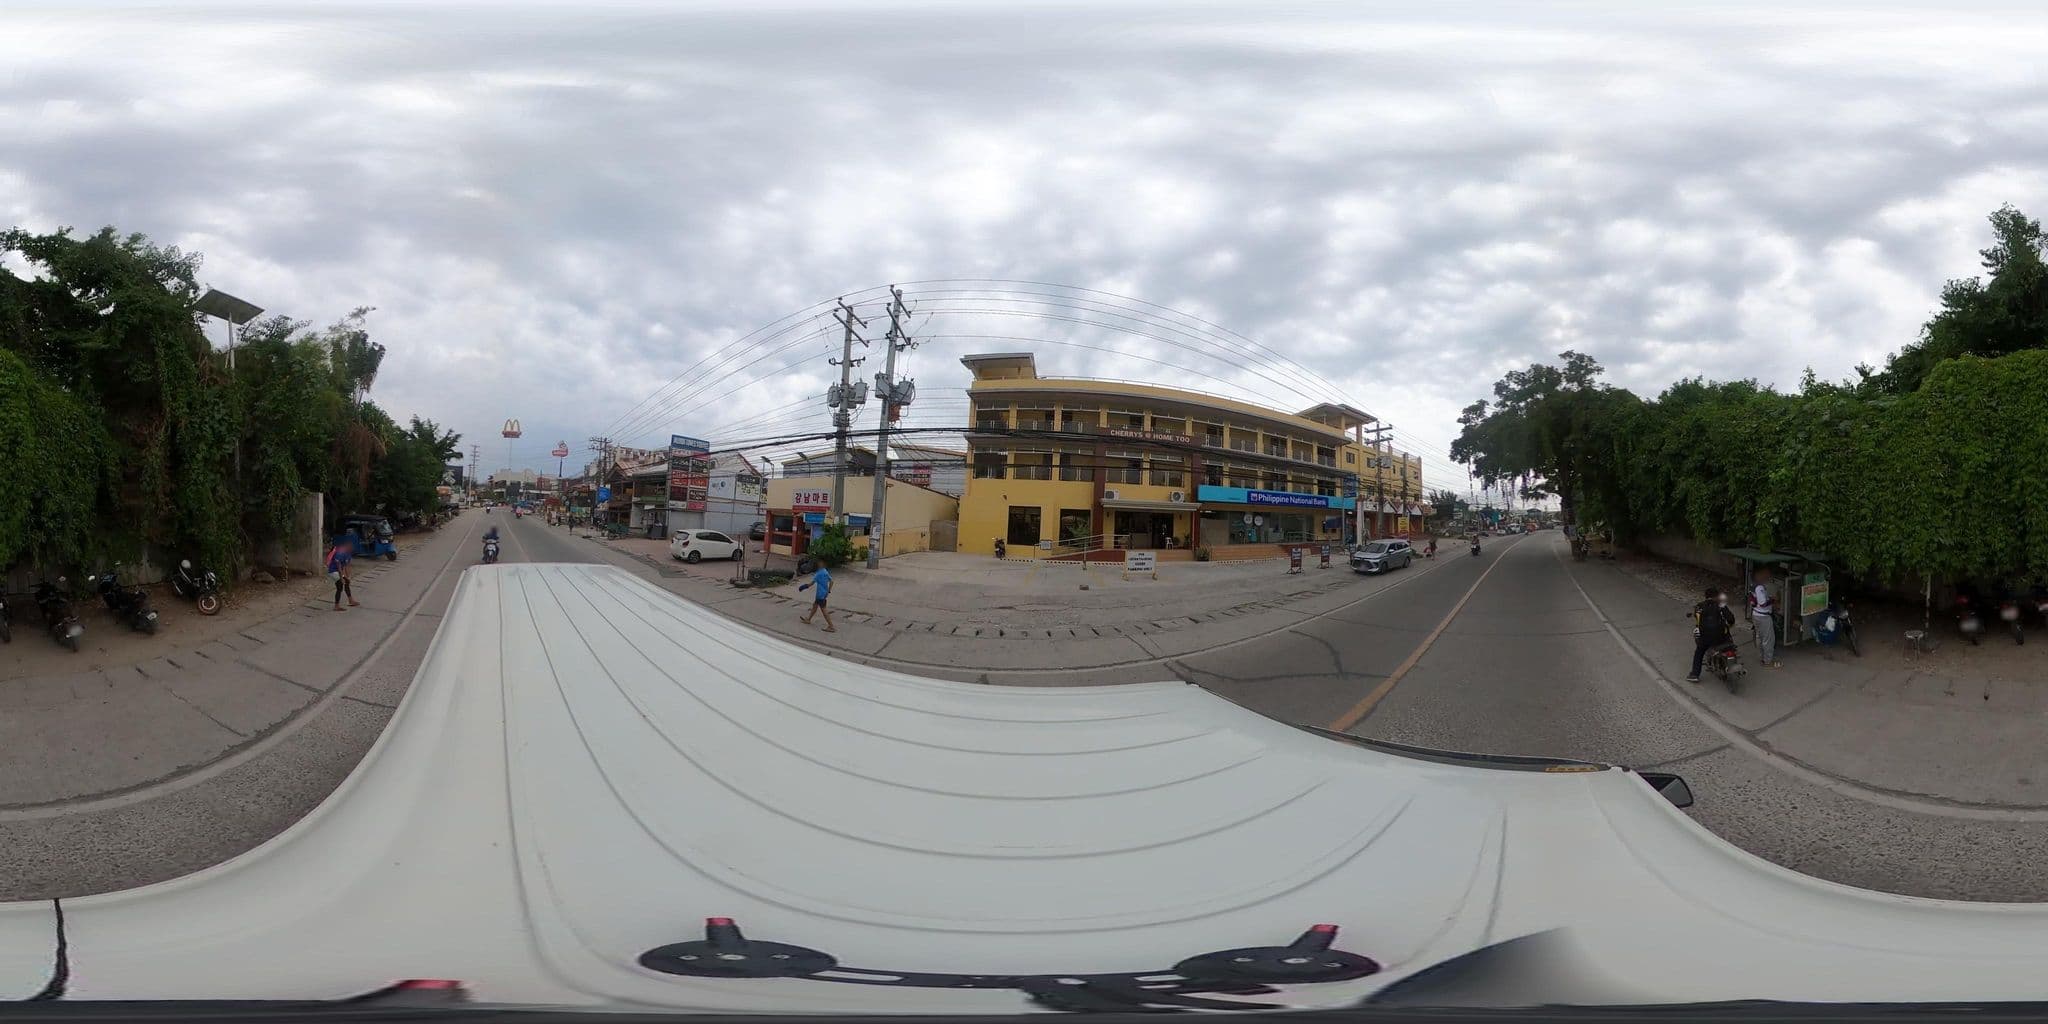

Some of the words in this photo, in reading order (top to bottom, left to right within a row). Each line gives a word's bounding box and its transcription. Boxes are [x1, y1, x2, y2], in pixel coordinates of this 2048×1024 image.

[1110, 430, 1143, 438] CHERRYS
[1153, 433, 1174, 441] HOME
[1175, 435, 1190, 443] TOO
[795, 492, 829, 504] 강남마트
[1258, 494, 1289, 504] Philippine
[1290, 497, 1313, 505] National
[1314, 498, 1326, 506] Bank
